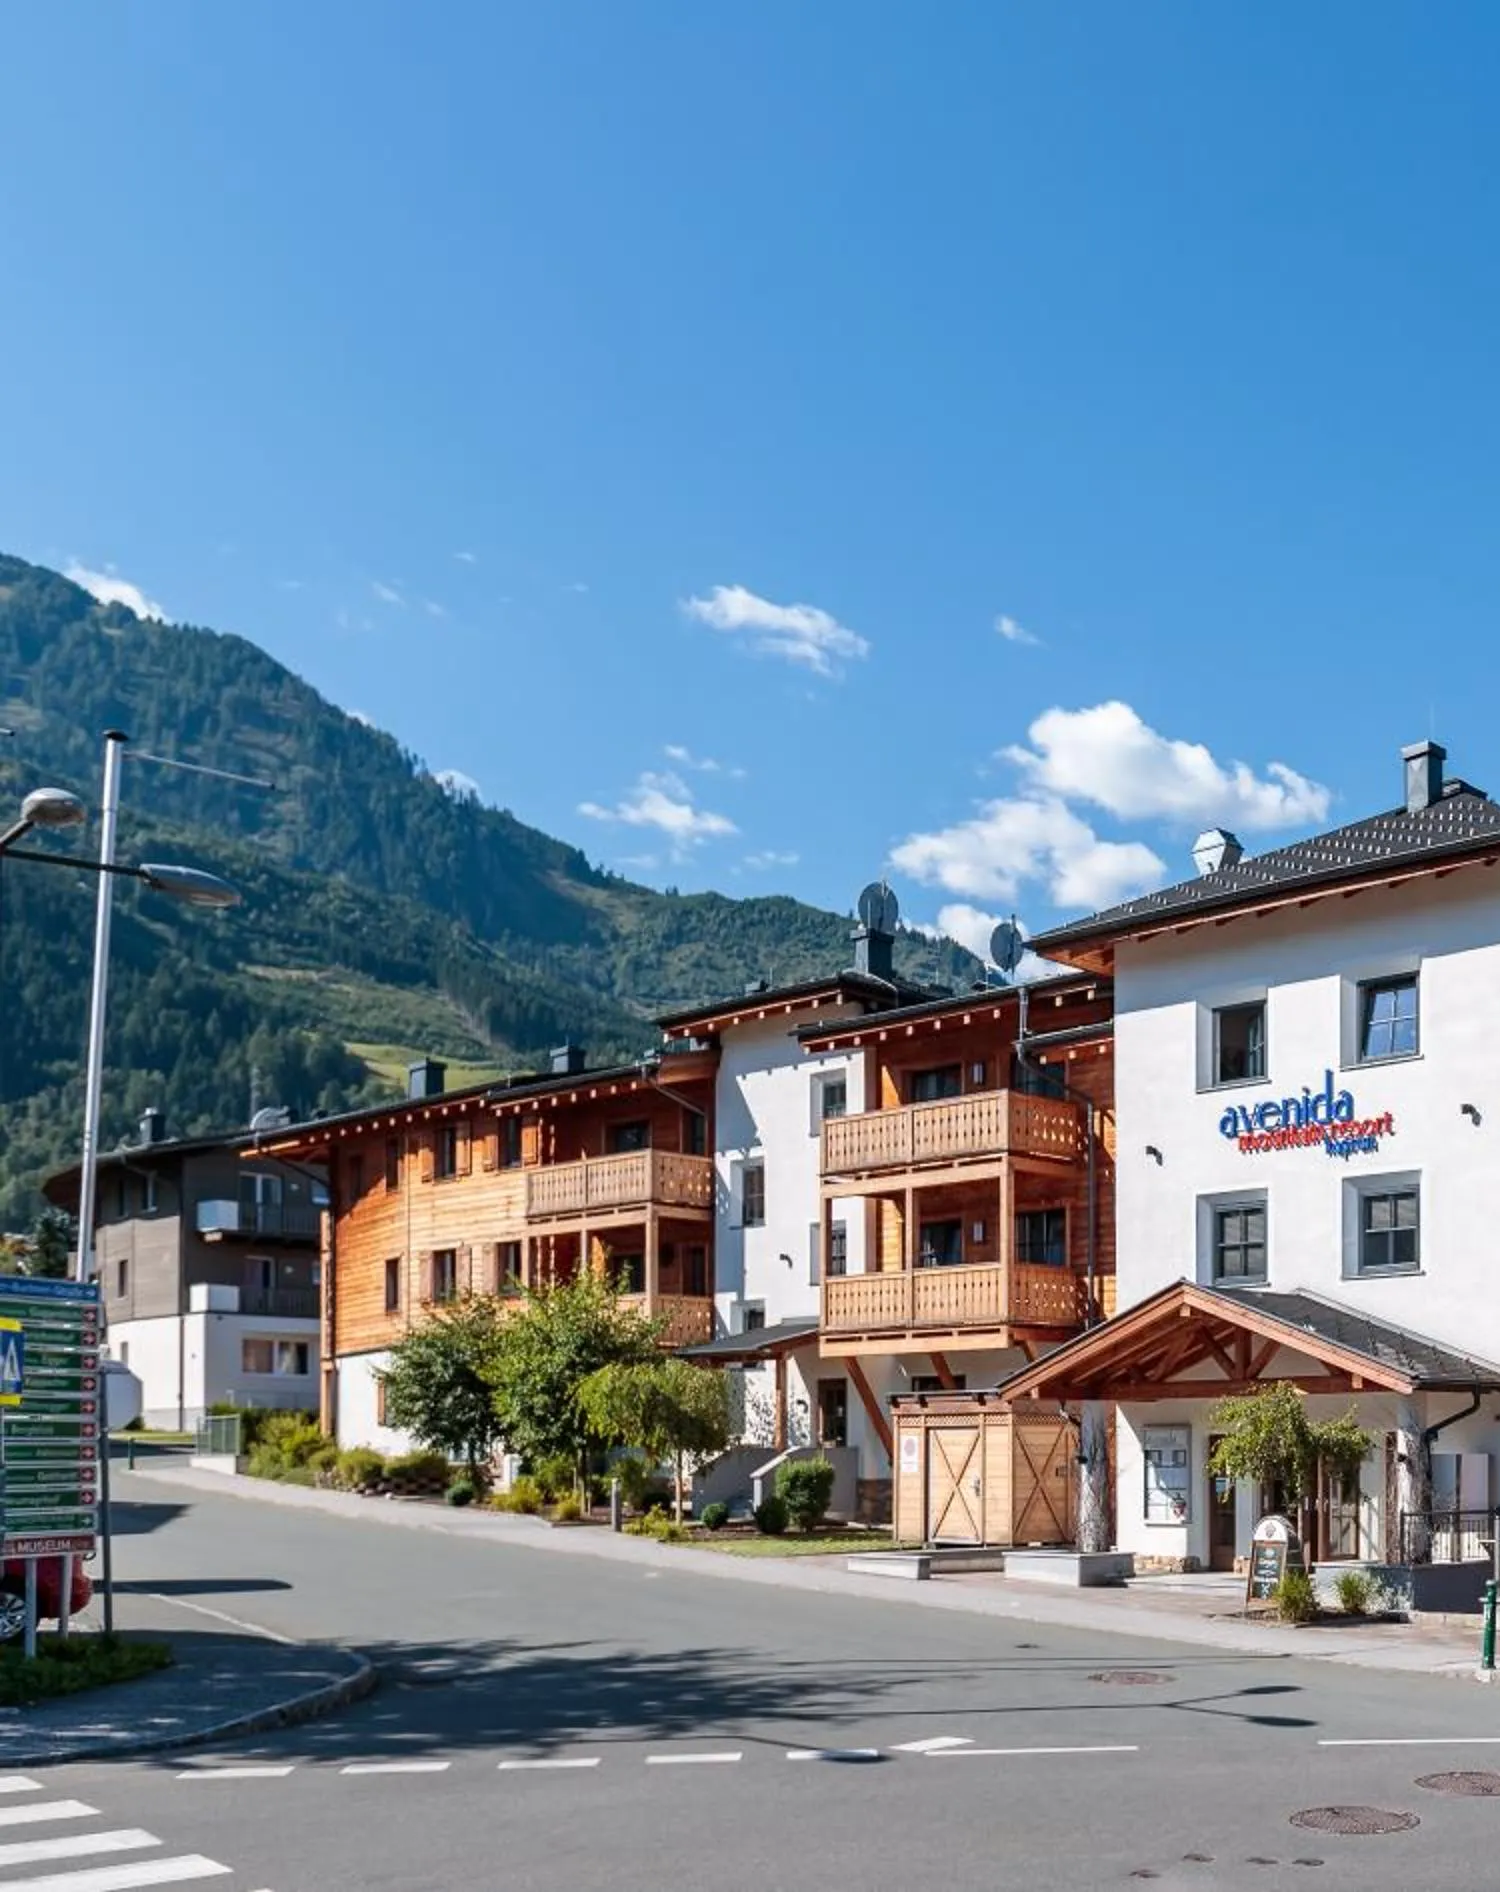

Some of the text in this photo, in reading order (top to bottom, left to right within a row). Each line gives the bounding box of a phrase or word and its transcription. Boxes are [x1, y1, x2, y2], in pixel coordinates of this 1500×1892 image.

[1219, 1069, 1355, 1139] avenida
[1330, 1111, 1396, 1141] resort
[17, 1539, 71, 1554] MUSEUM
